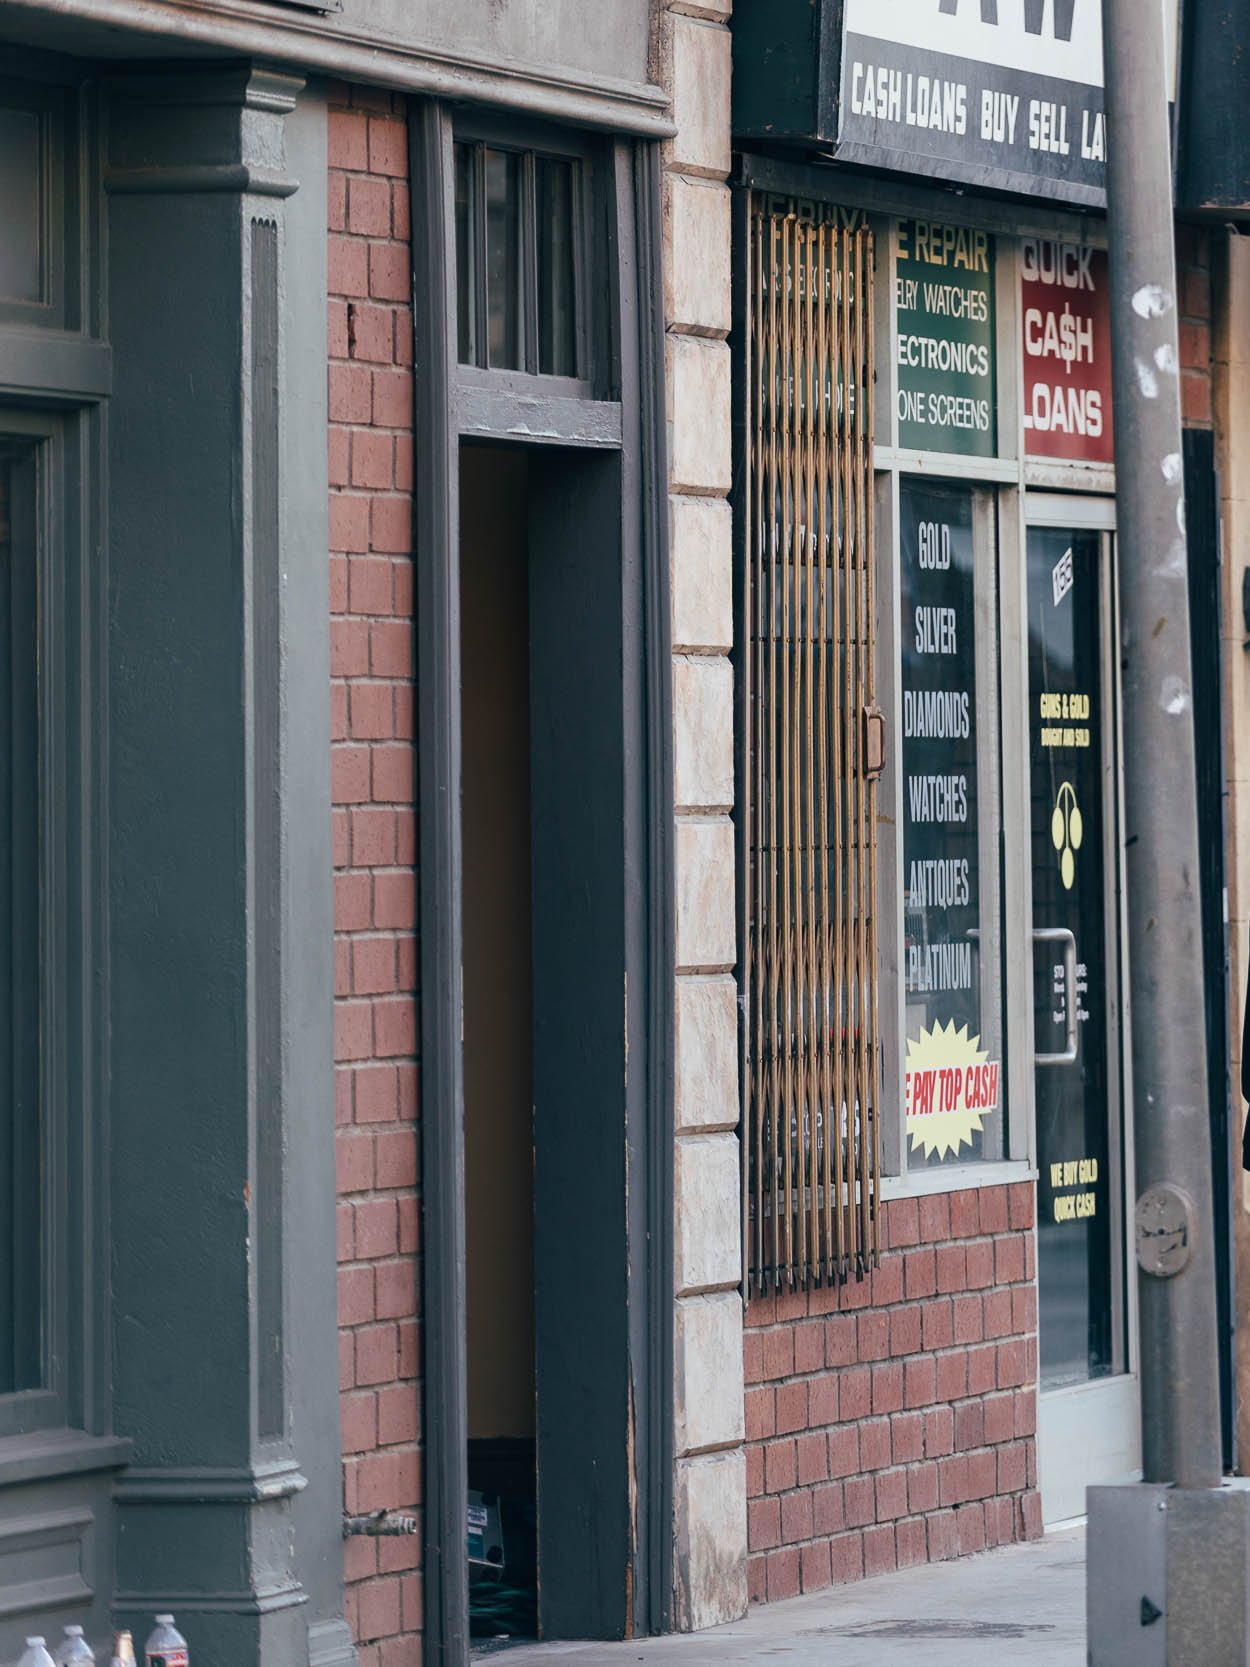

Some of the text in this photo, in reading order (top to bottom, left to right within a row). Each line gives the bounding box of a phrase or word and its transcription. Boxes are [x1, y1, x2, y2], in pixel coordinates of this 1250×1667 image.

[851, 61, 1107, 163] CASH LOANS BUY SELL LA
[915, 220, 989, 273] REPAIR
[1021, 238, 1096, 291] QUICK
[923, 282, 988, 323] WATCHES
[898, 334, 989, 376] ECTRONICS
[928, 393, 989, 431] SCREENS
[918, 521, 951, 570] GOLD
[915, 605, 957, 655] SILVER
[904, 690, 970, 739] DIAMONDS
[1070, 694, 1090, 719] GOLD
[908, 774, 968, 823] WATCHES
[908, 858, 970, 911] ANTIQUES
[909, 942, 972, 993] PLATINUM
[912, 1070, 938, 1116] PAY
[939, 1067, 963, 1112] TOP
[965, 1063, 999, 1110] CASH
[1050, 1158, 1098, 1188] WE BUY GOLD
[1076, 1192, 1096, 1218] CASH
